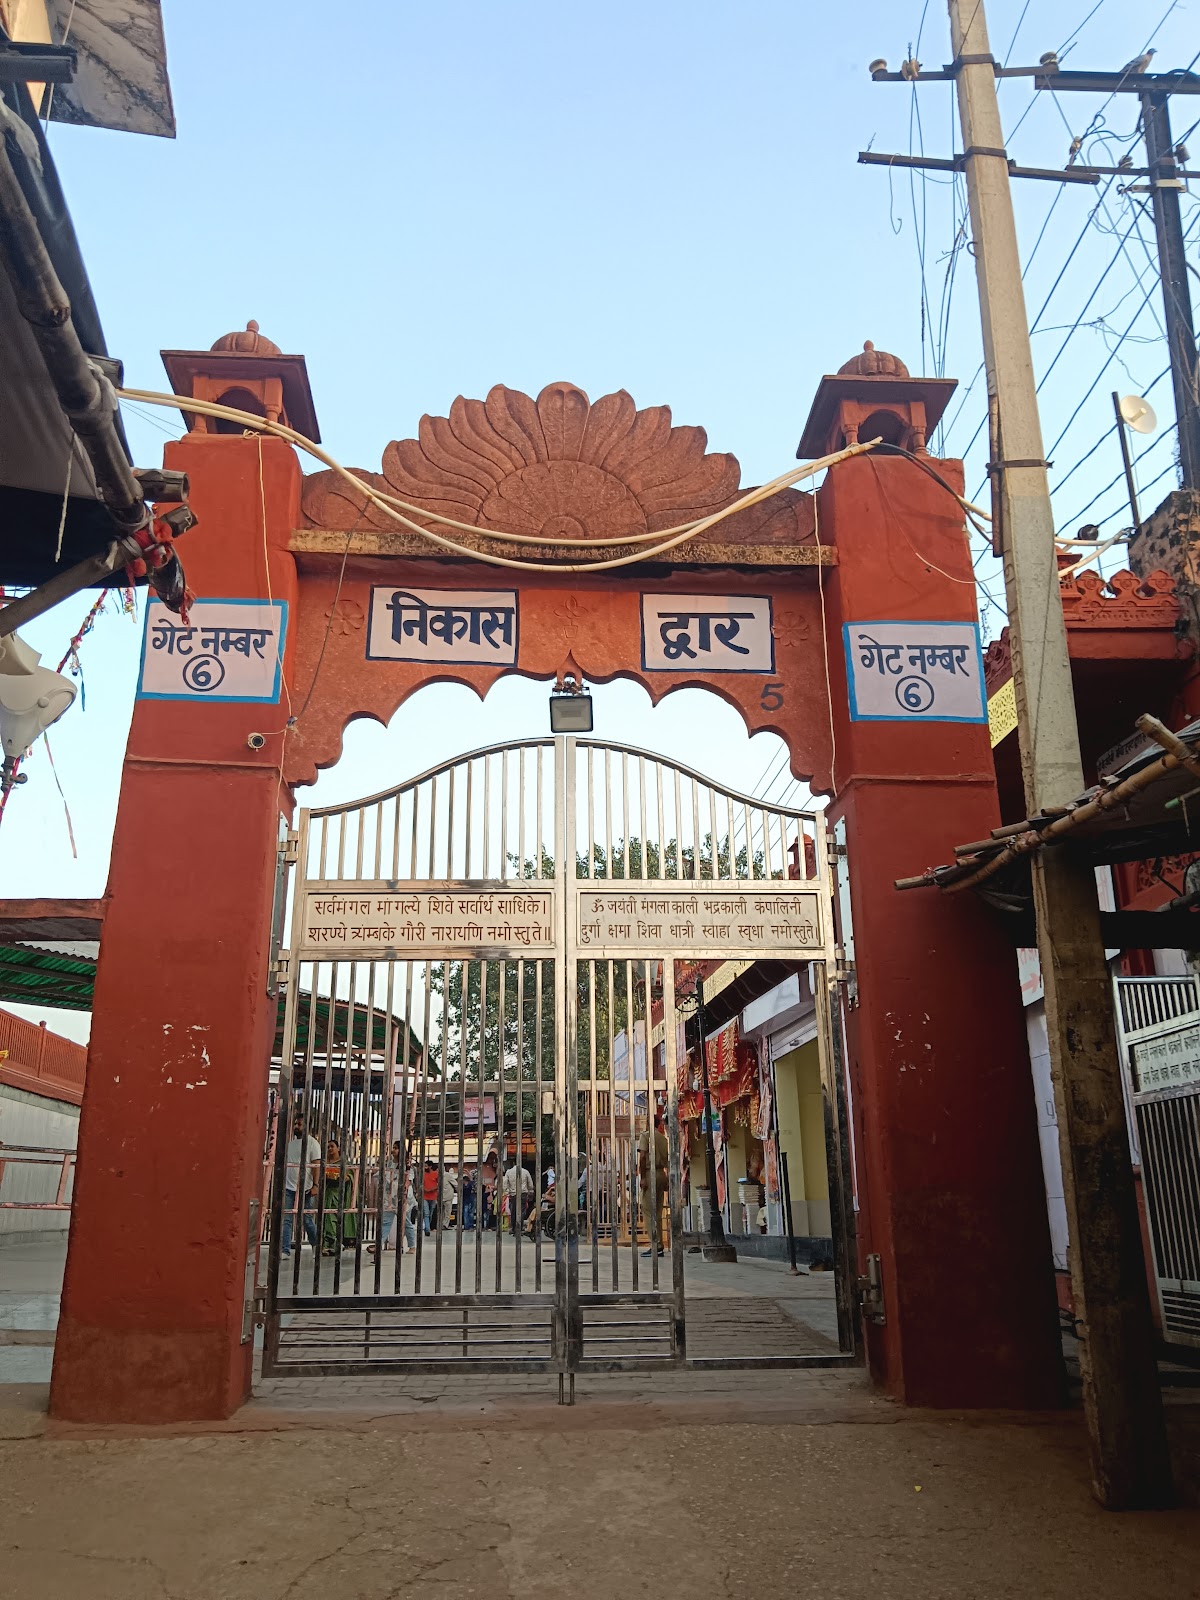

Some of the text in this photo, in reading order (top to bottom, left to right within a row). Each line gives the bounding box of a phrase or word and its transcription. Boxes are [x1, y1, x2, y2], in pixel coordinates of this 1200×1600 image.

[386, 591, 756, 659] निकास द्वार
[152, 618, 273, 659] गेट नम्बर
[858, 634, 970, 677] गेट नम्बर
[760, 683, 785, 711] 5
[428, 895, 454, 914] शिवे
[458, 895, 493, 914] सर्वार्थ
[591, 898, 604, 913] ॐ
[607, 895, 637, 914] जयंती
[703, 896, 747, 914] भद्रकाली
[308, 922, 347, 941] शरण्ये
[400, 920, 426, 941] गौरी
[431, 922, 483, 940] नारायणि
[581, 918, 601, 943] दुर्गा
[608, 924, 631, 939] क्षमा
[637, 920, 662, 939] शिवा
[670, 920, 694, 938] धात्री
[702, 925, 730, 938] स्वाहा
